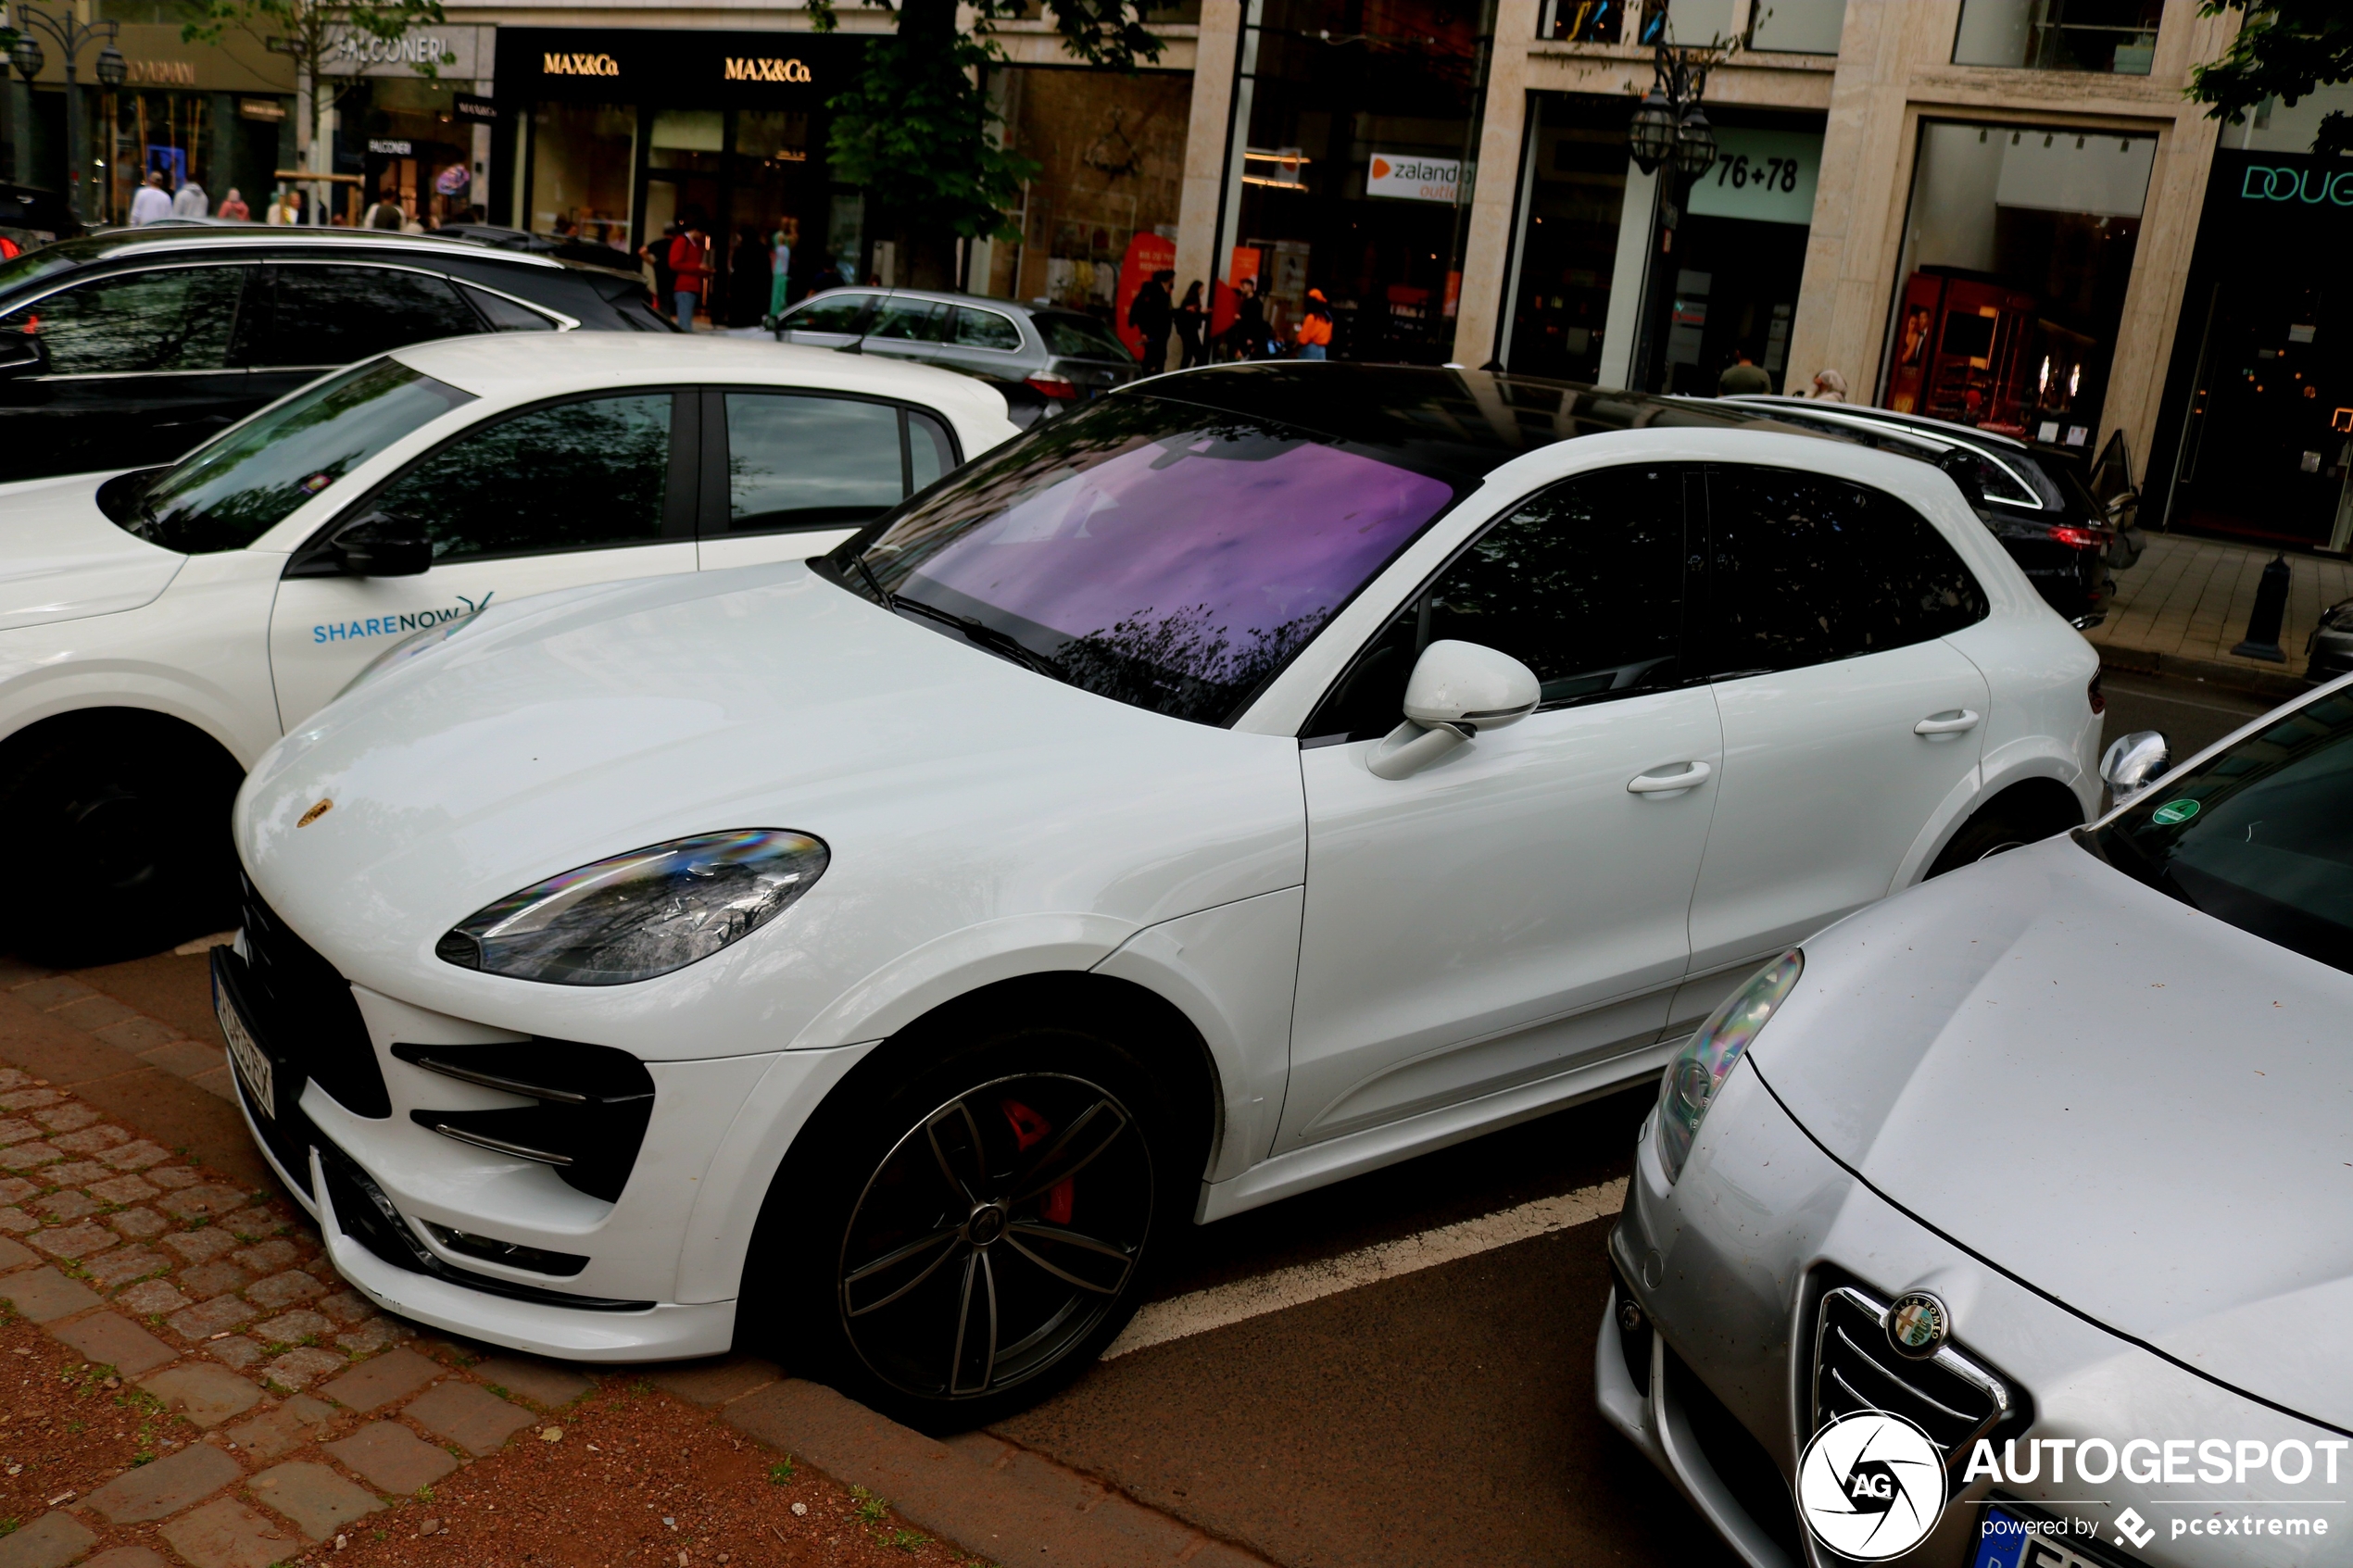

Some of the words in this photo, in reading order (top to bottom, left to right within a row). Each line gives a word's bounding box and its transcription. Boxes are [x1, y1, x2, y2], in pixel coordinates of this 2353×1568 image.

[338, 36, 448, 64] FALCONERI
[1393, 159, 1473, 185] zalando
[313, 608, 459, 644] SHARENOW
[1894, 1298, 1919, 1315] ALFA
[1924, 1301, 1941, 1339] ROMEO
